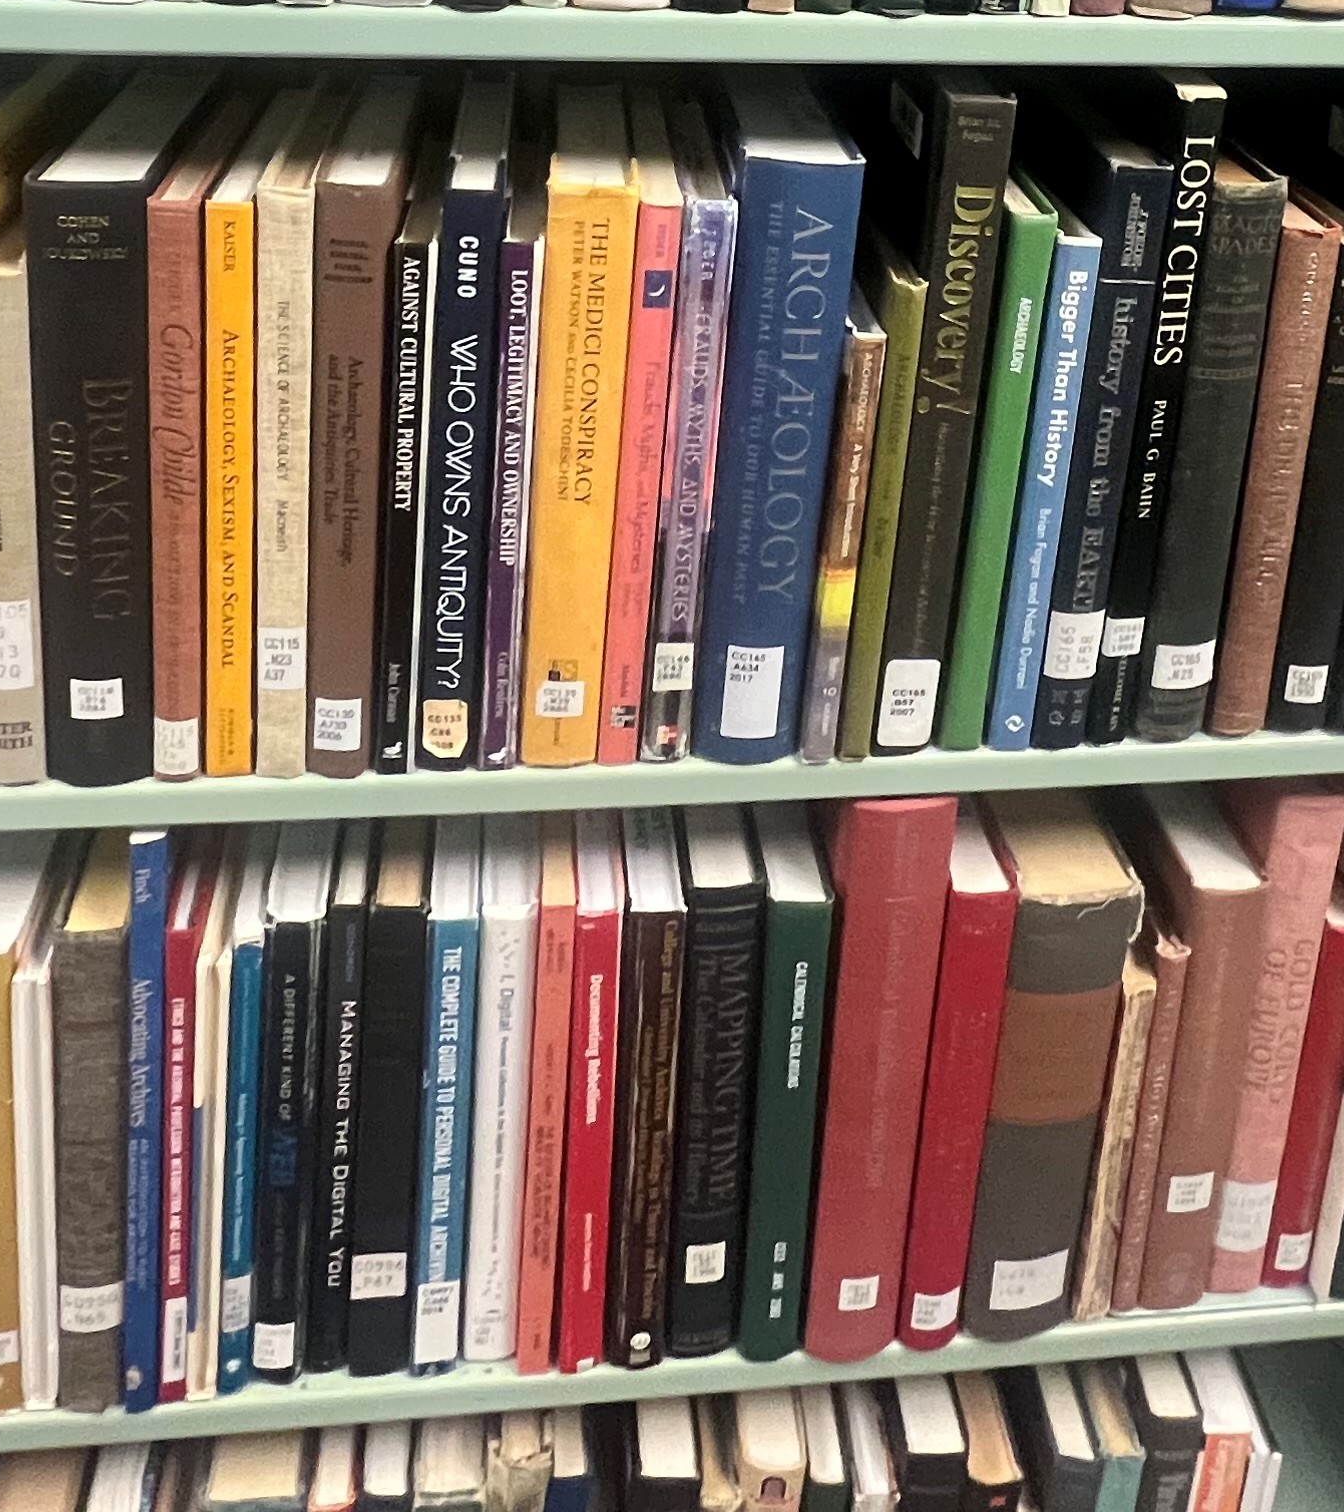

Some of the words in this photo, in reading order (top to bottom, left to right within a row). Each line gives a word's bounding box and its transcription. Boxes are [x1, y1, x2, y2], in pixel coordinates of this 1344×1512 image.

[1171, 132, 1216, 237] LOST
[455, 234, 480, 299] CUNO
[588, 216, 611, 266] THE
[400, 255, 421, 333] AGAINST
[508, 268, 529, 321] LOOT,
[582, 272, 606, 356] MEDICI
[916, 182, 996, 418] Discovery!
[1058, 269, 1089, 344] Bigger
[1152, 243, 1198, 367] CITIES
[396, 336, 418, 425] CULTURAL
[446, 332, 479, 413] WHO
[499, 324, 529, 427] LEGITIMACY
[1051, 347, 1080, 403] Than
[503, 429, 521, 466] AND
[572, 361, 600, 505] CONSPIRACY
[1036, 407, 1076, 487] History
[1147, 398, 1168, 444] PAUL
[393, 427, 415, 512] PROPERTY
[441, 419, 475, 518] OWNS
[1136, 470, 1157, 519] BAHN
[498, 469, 521, 566] OWNERSHIP
[434, 522, 469, 689] ANTIQUITY?
[441, 944, 463, 973] THE
[438, 974, 461, 1043] COMPLETE
[335, 999, 357, 1111] MANAGING
[436, 1044, 457, 1084] GUIDE
[435, 1085, 456, 1104] TO
[332, 1115, 350, 1158] THE
[432, 1105, 454, 1173] PERSONAL
[328, 1163, 350, 1241] DIGITAL
[430, 1172, 451, 1223] DIGITAL
[326, 1245, 346, 1288] YOU
